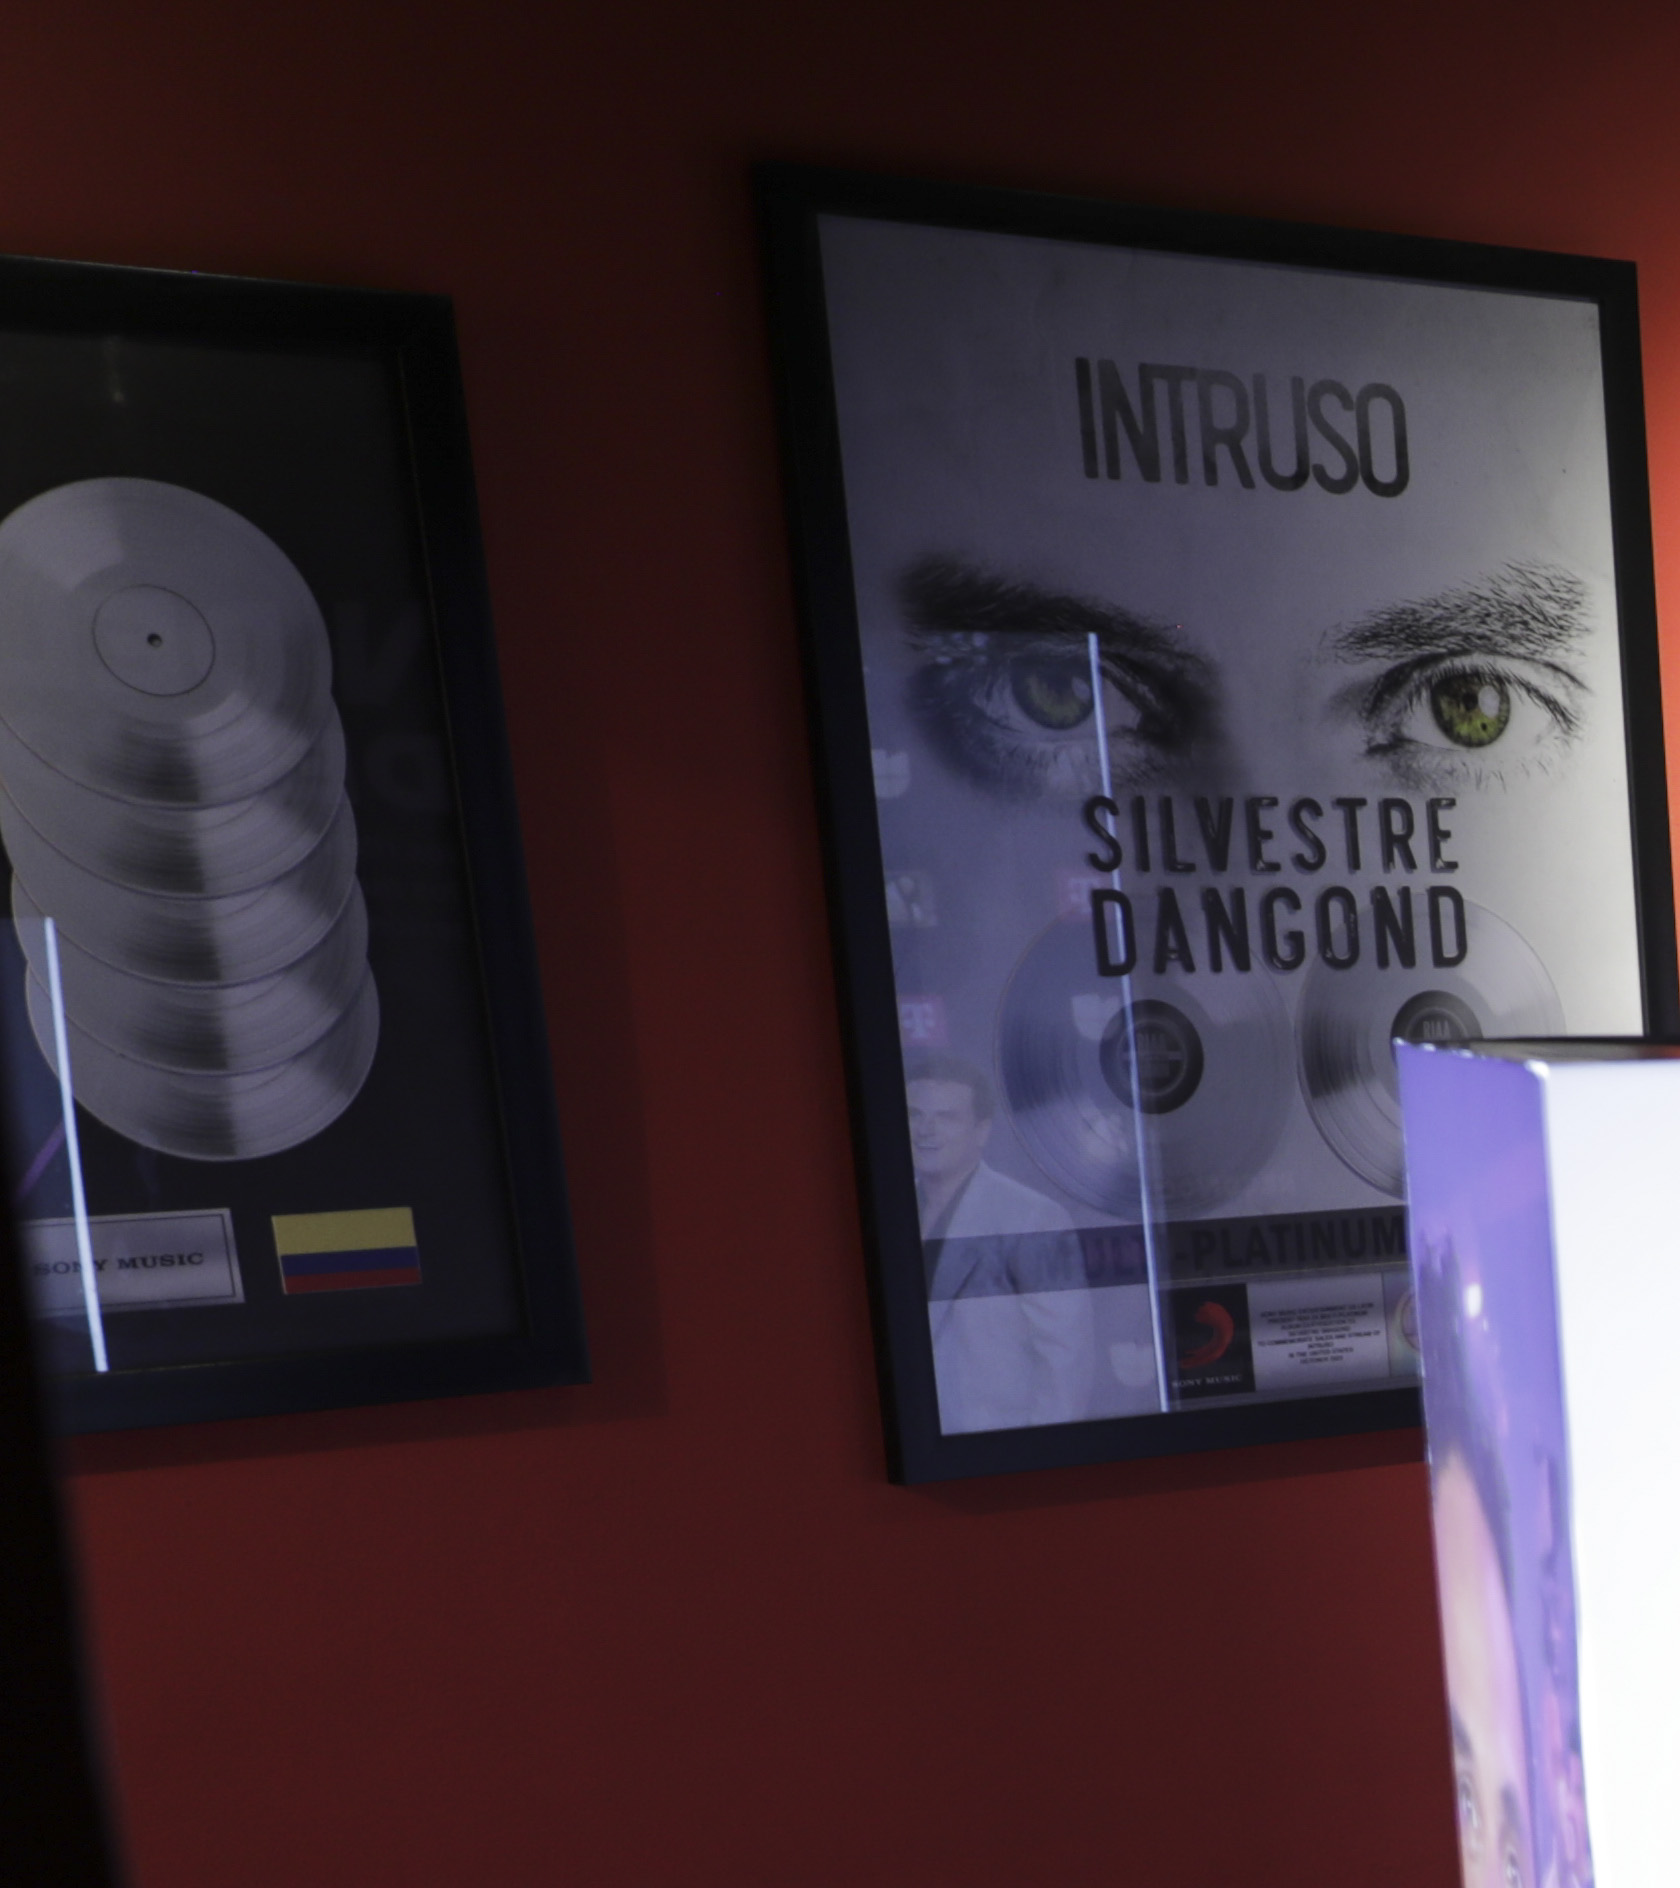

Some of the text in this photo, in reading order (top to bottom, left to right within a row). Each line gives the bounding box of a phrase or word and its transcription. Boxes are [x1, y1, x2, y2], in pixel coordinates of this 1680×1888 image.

[1075, 357, 1410, 498] INTRUSO
[1084, 796, 1459, 876] SILVESTRE
[1091, 886, 1467, 978] DANGOND
[1423, 1020, 1450, 1040] RIAA
[118, 1253, 204, 1270] MUSIC
[1172, 1373, 1242, 1389] SONY MUSIC
